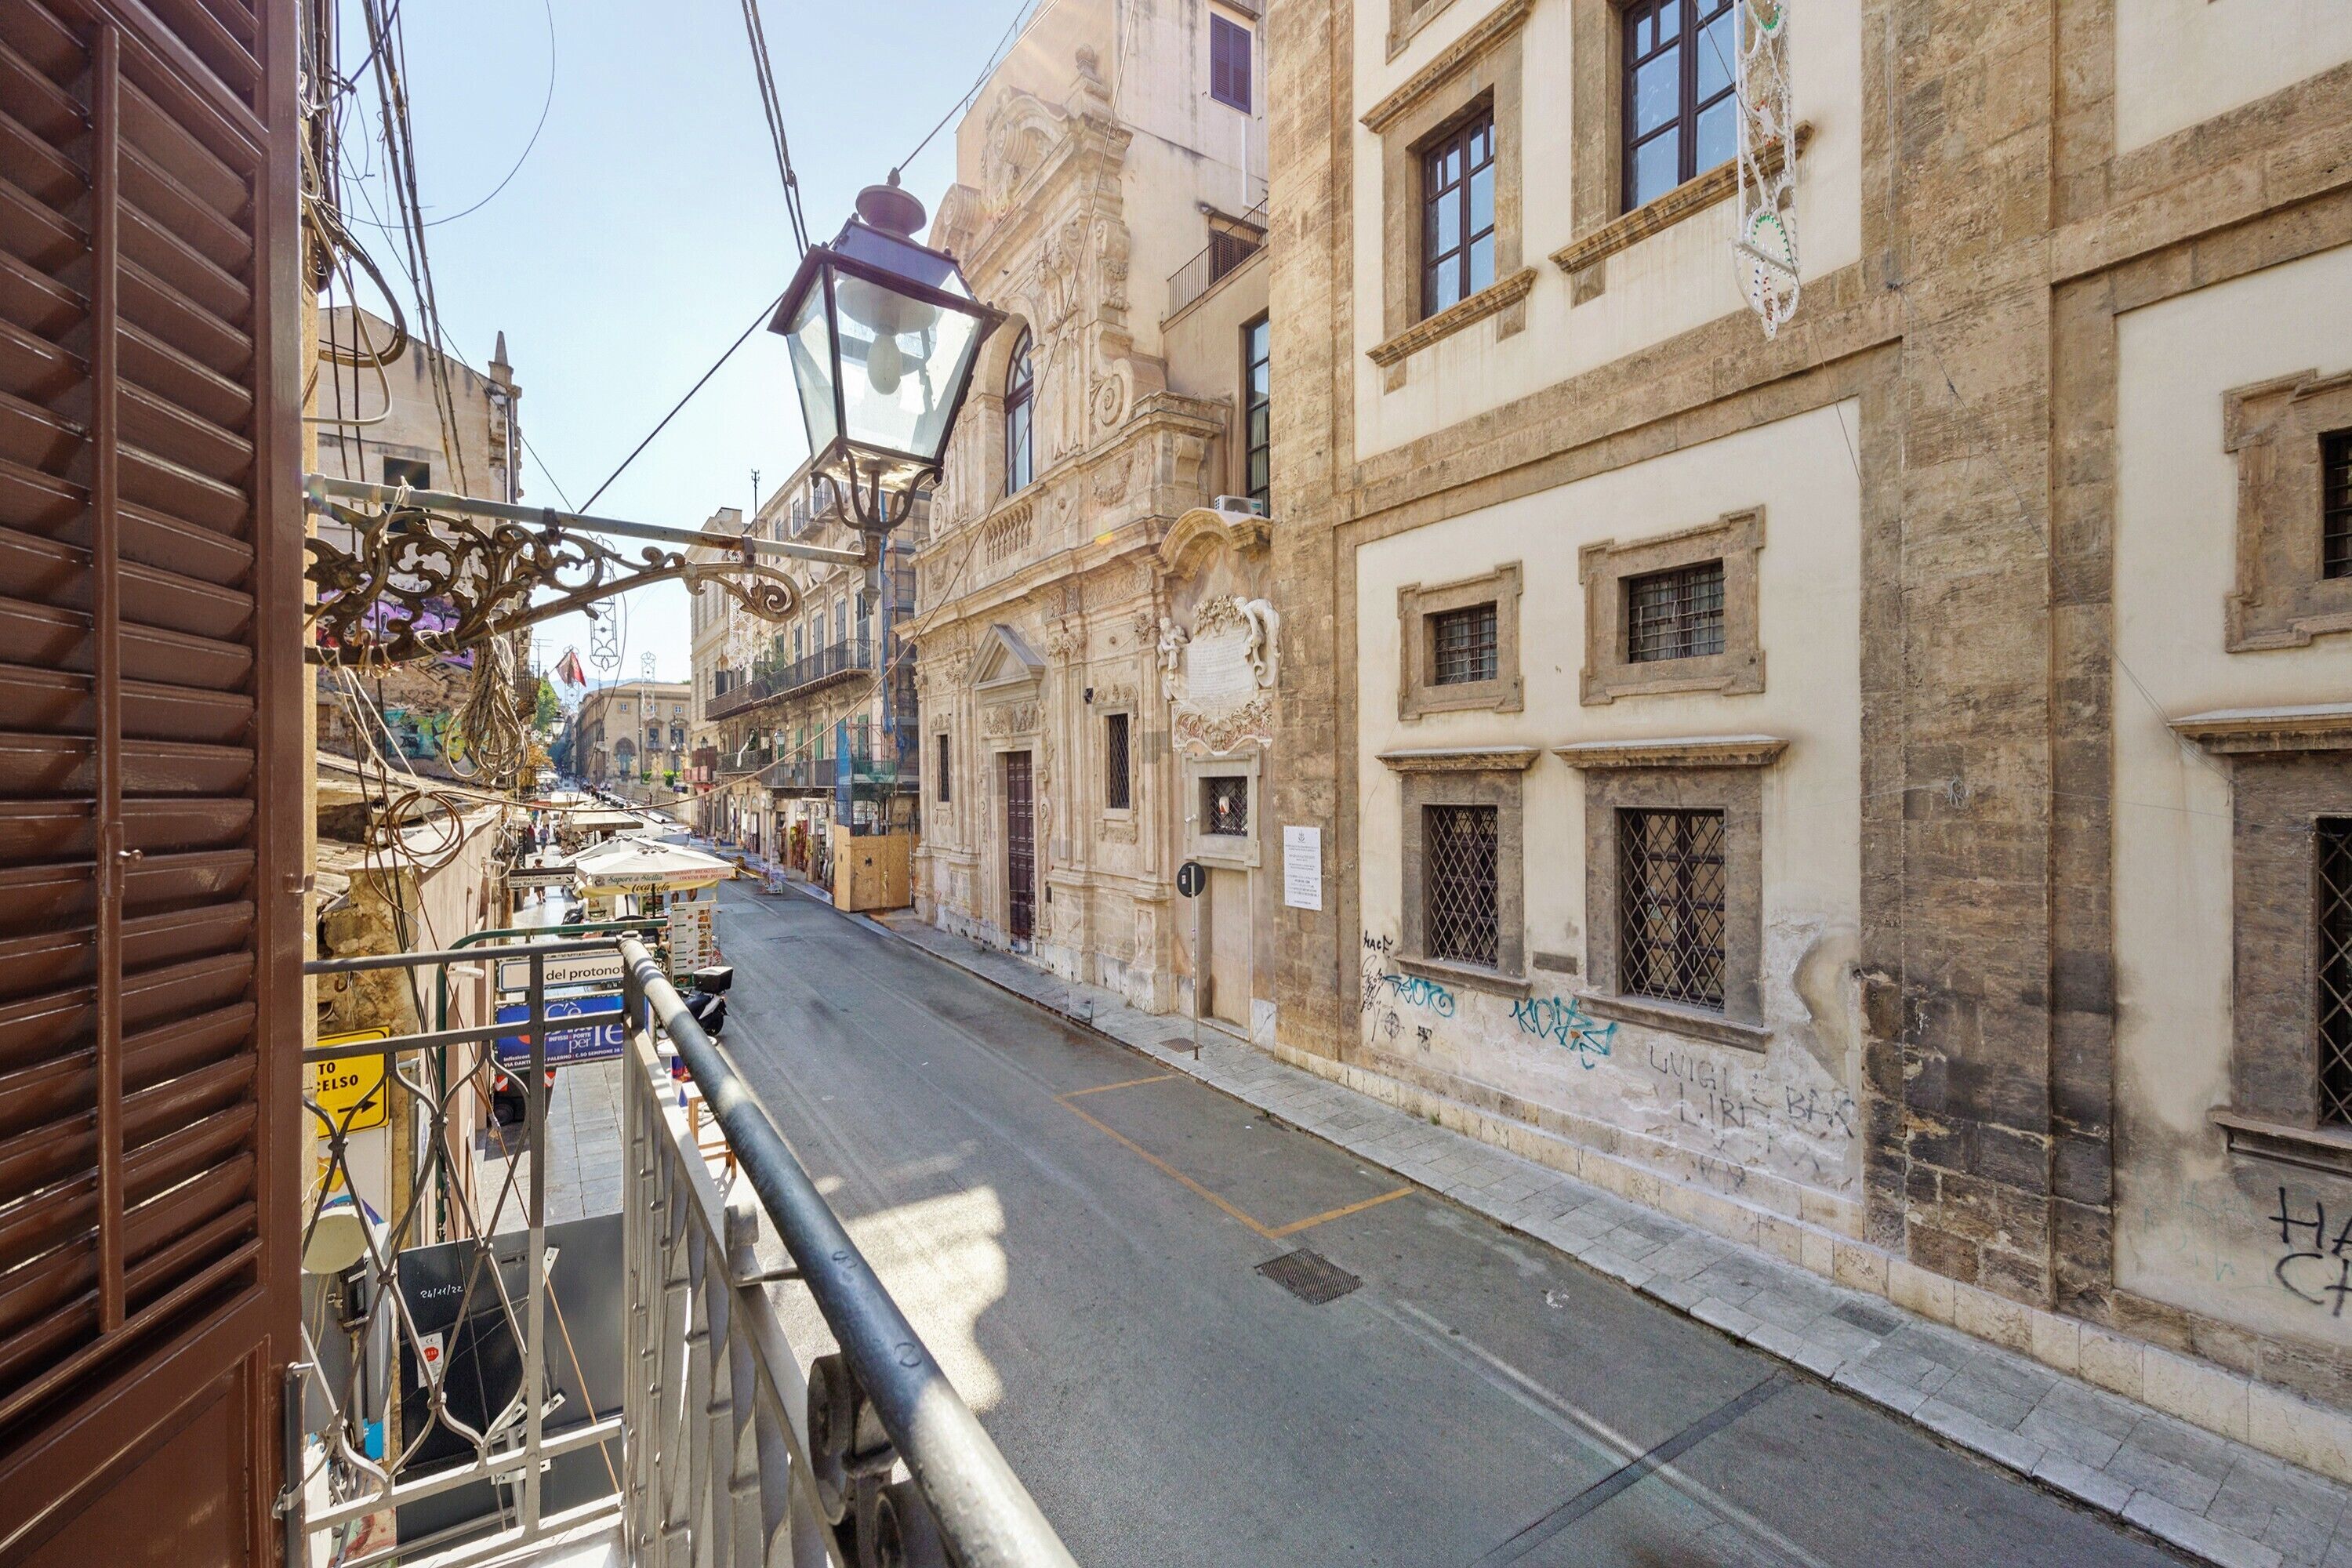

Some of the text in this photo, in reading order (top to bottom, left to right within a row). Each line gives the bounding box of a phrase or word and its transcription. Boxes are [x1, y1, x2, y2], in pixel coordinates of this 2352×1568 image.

[608, 876, 633, 884] Sapore
[546, 969, 565, 980] del
[569, 1037, 591, 1053] per
[318, 1062, 336, 1075] TO
[420, 1284, 464, 1298] 24/11/22
